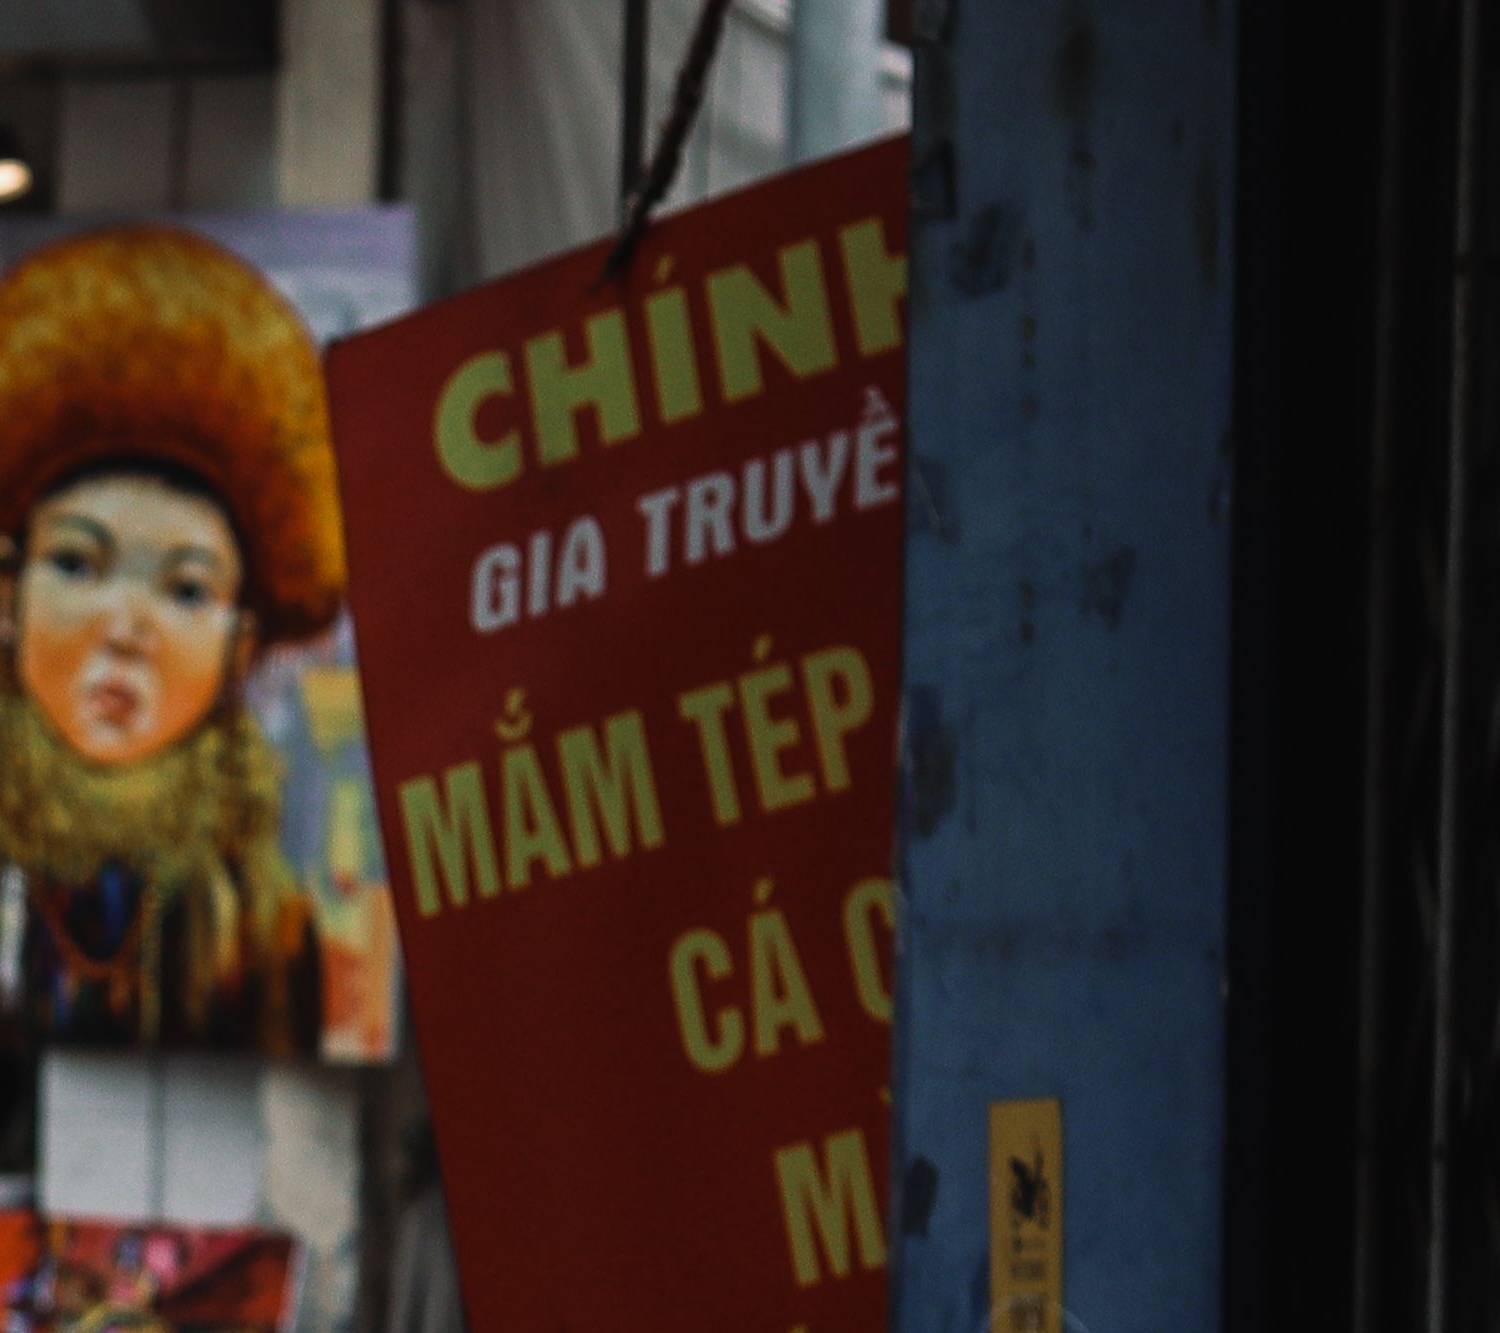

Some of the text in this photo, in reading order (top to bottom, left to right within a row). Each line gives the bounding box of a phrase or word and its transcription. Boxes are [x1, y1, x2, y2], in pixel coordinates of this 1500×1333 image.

[434, 218, 908, 490] CHÍNH
[471, 385, 898, 633] GIA TRUYỀ
[399, 636, 875, 919] MẮM TÉP
[669, 879, 824, 1074] CÁ
